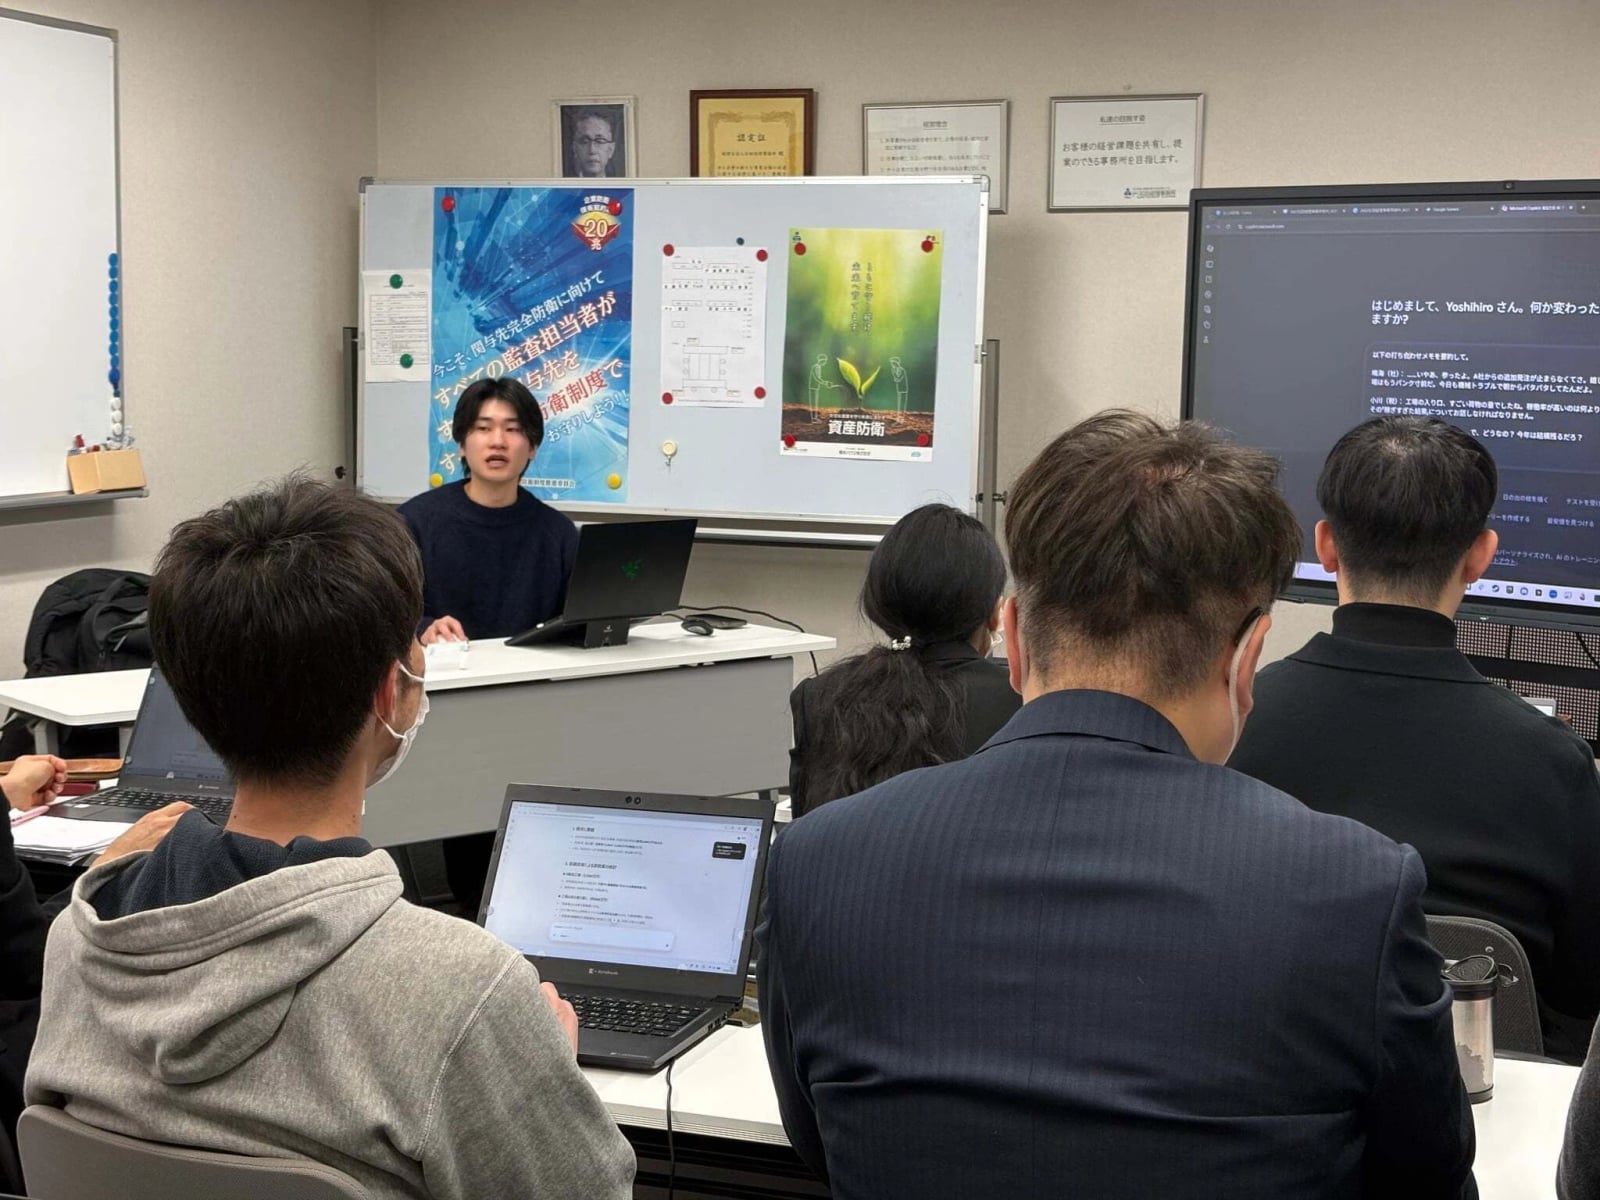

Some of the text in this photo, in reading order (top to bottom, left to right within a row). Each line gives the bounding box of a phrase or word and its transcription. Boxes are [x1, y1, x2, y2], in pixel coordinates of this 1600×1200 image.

[585, 219, 608, 238] 20
[1446, 301, 1493, 313] Yoshihiro
[433, 270, 605, 378] 今こそ、関与先完全防衛に向けて
[828, 420, 885, 437] 資産防衛
[1488, 514, 1530, 523] リーを作成する
